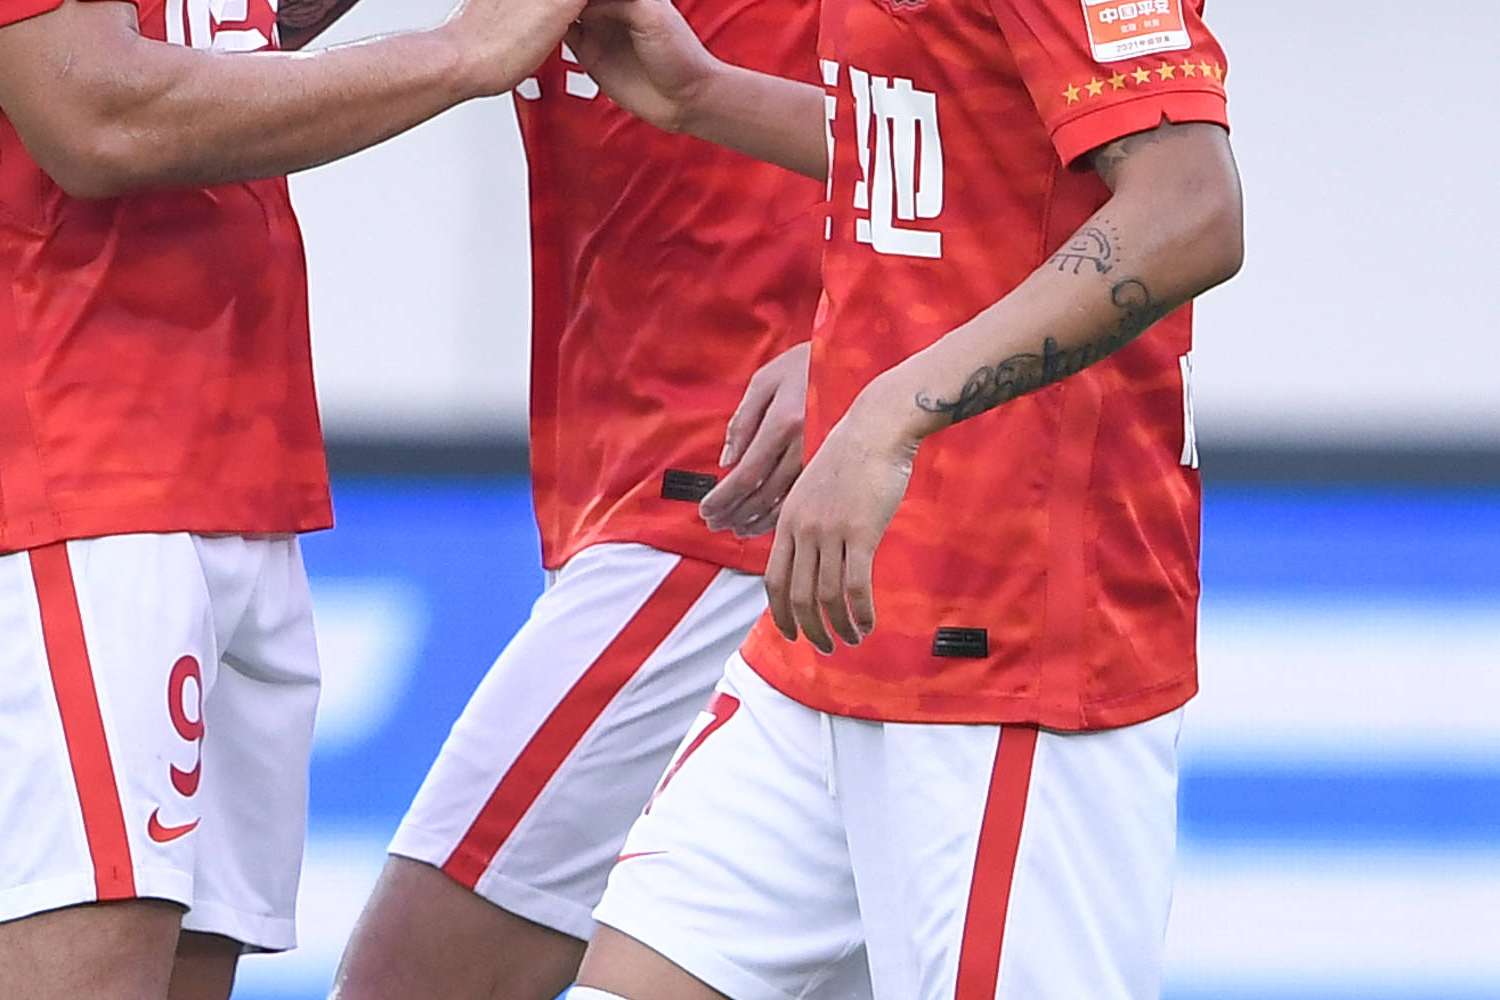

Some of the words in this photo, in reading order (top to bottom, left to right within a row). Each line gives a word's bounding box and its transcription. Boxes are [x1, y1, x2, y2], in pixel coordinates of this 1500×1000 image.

[1099, 0, 1170, 23] 中国平安
[819, 59, 943, 259] 驰
[168, 655, 204, 797] 9
